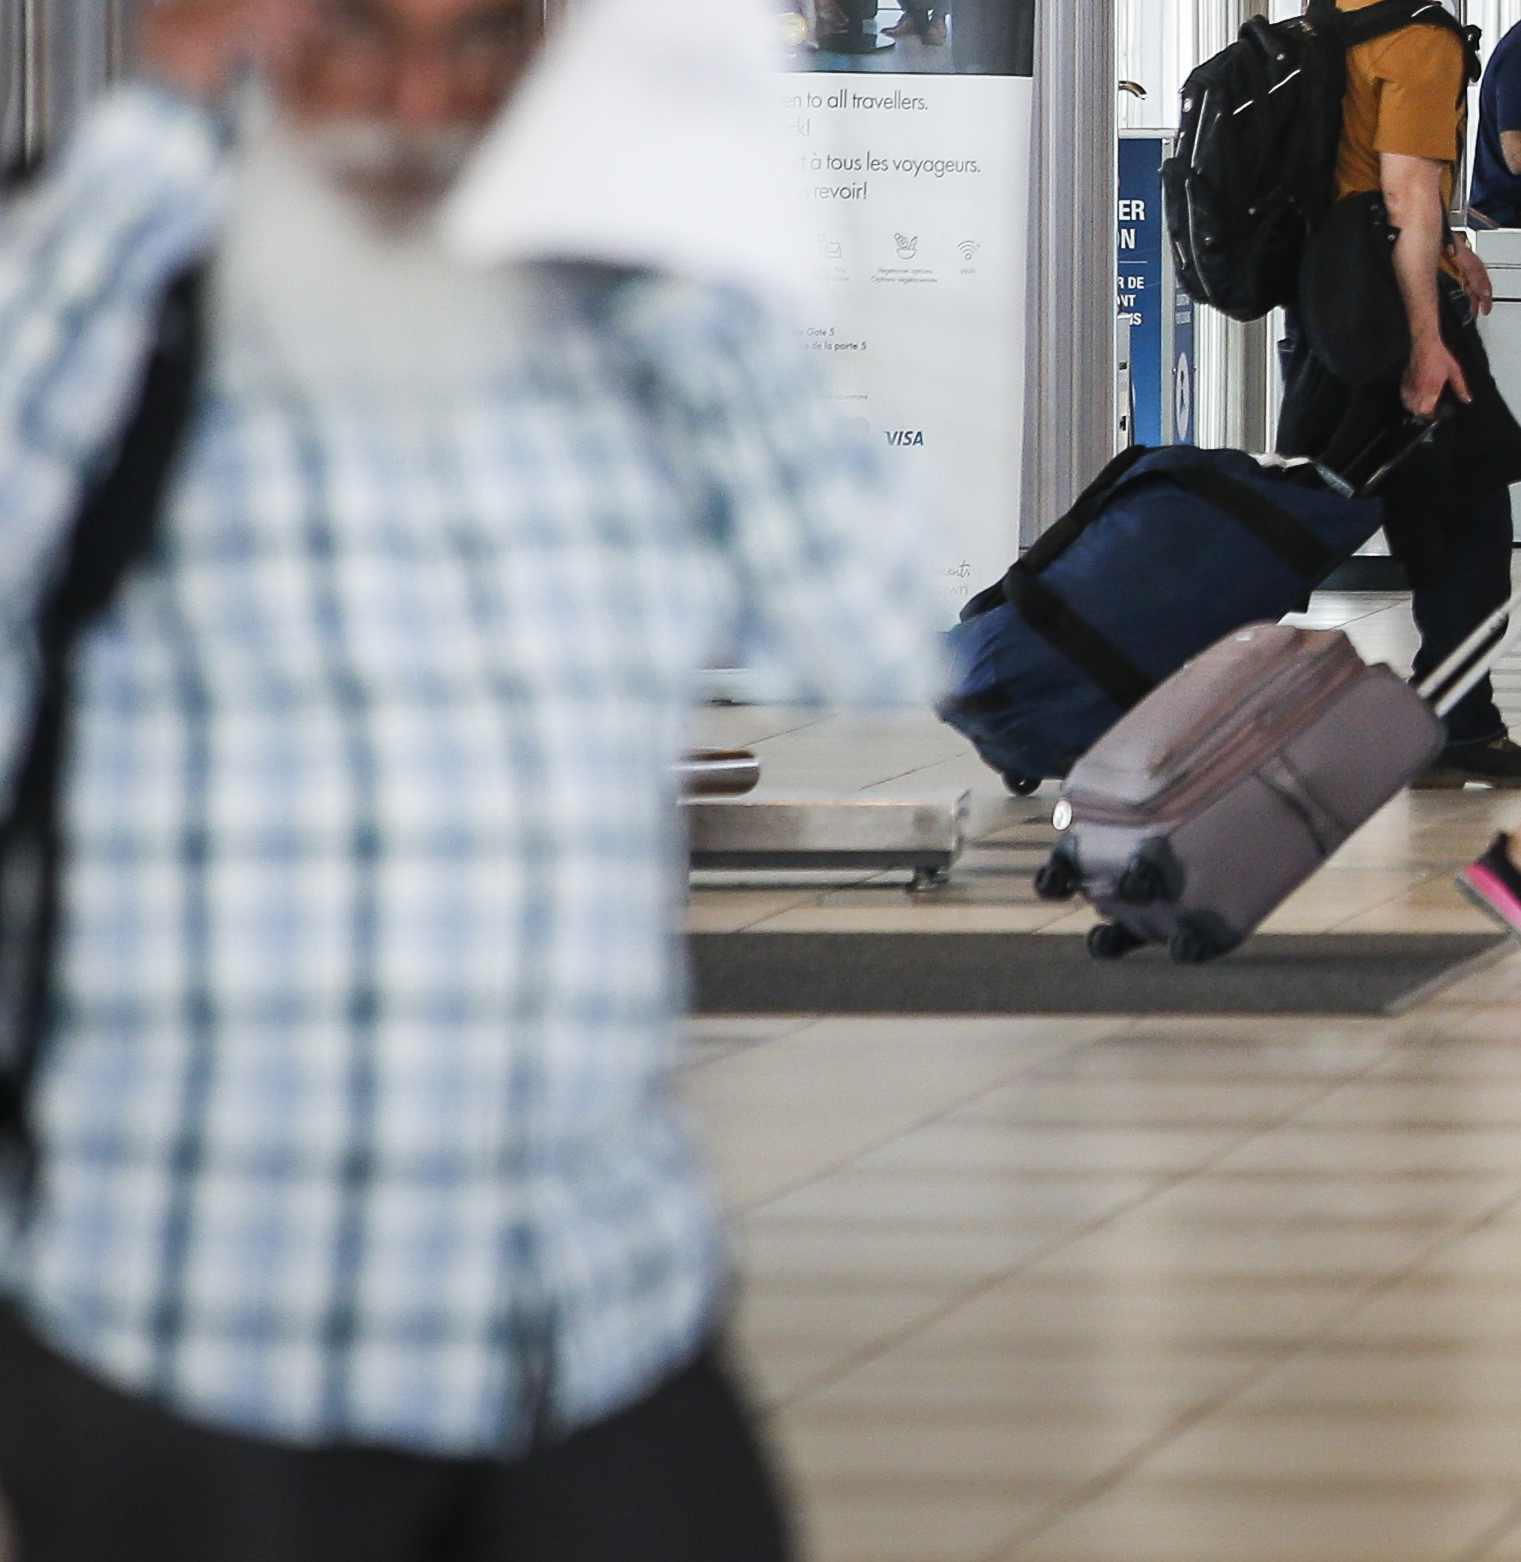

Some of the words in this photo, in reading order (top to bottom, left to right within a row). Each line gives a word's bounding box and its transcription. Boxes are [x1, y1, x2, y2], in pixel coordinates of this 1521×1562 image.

[807, 93, 822, 108] to
[827, 89, 847, 109] all
[853, 91, 928, 110] travellers.
[827, 155, 861, 171] tous
[867, 151, 888, 171] les
[893, 158, 981, 178] voyageurs.
[814, 182, 867, 200] revoir!
[1128, 277, 1144, 289] DE
[884, 431, 924, 446] VISA
